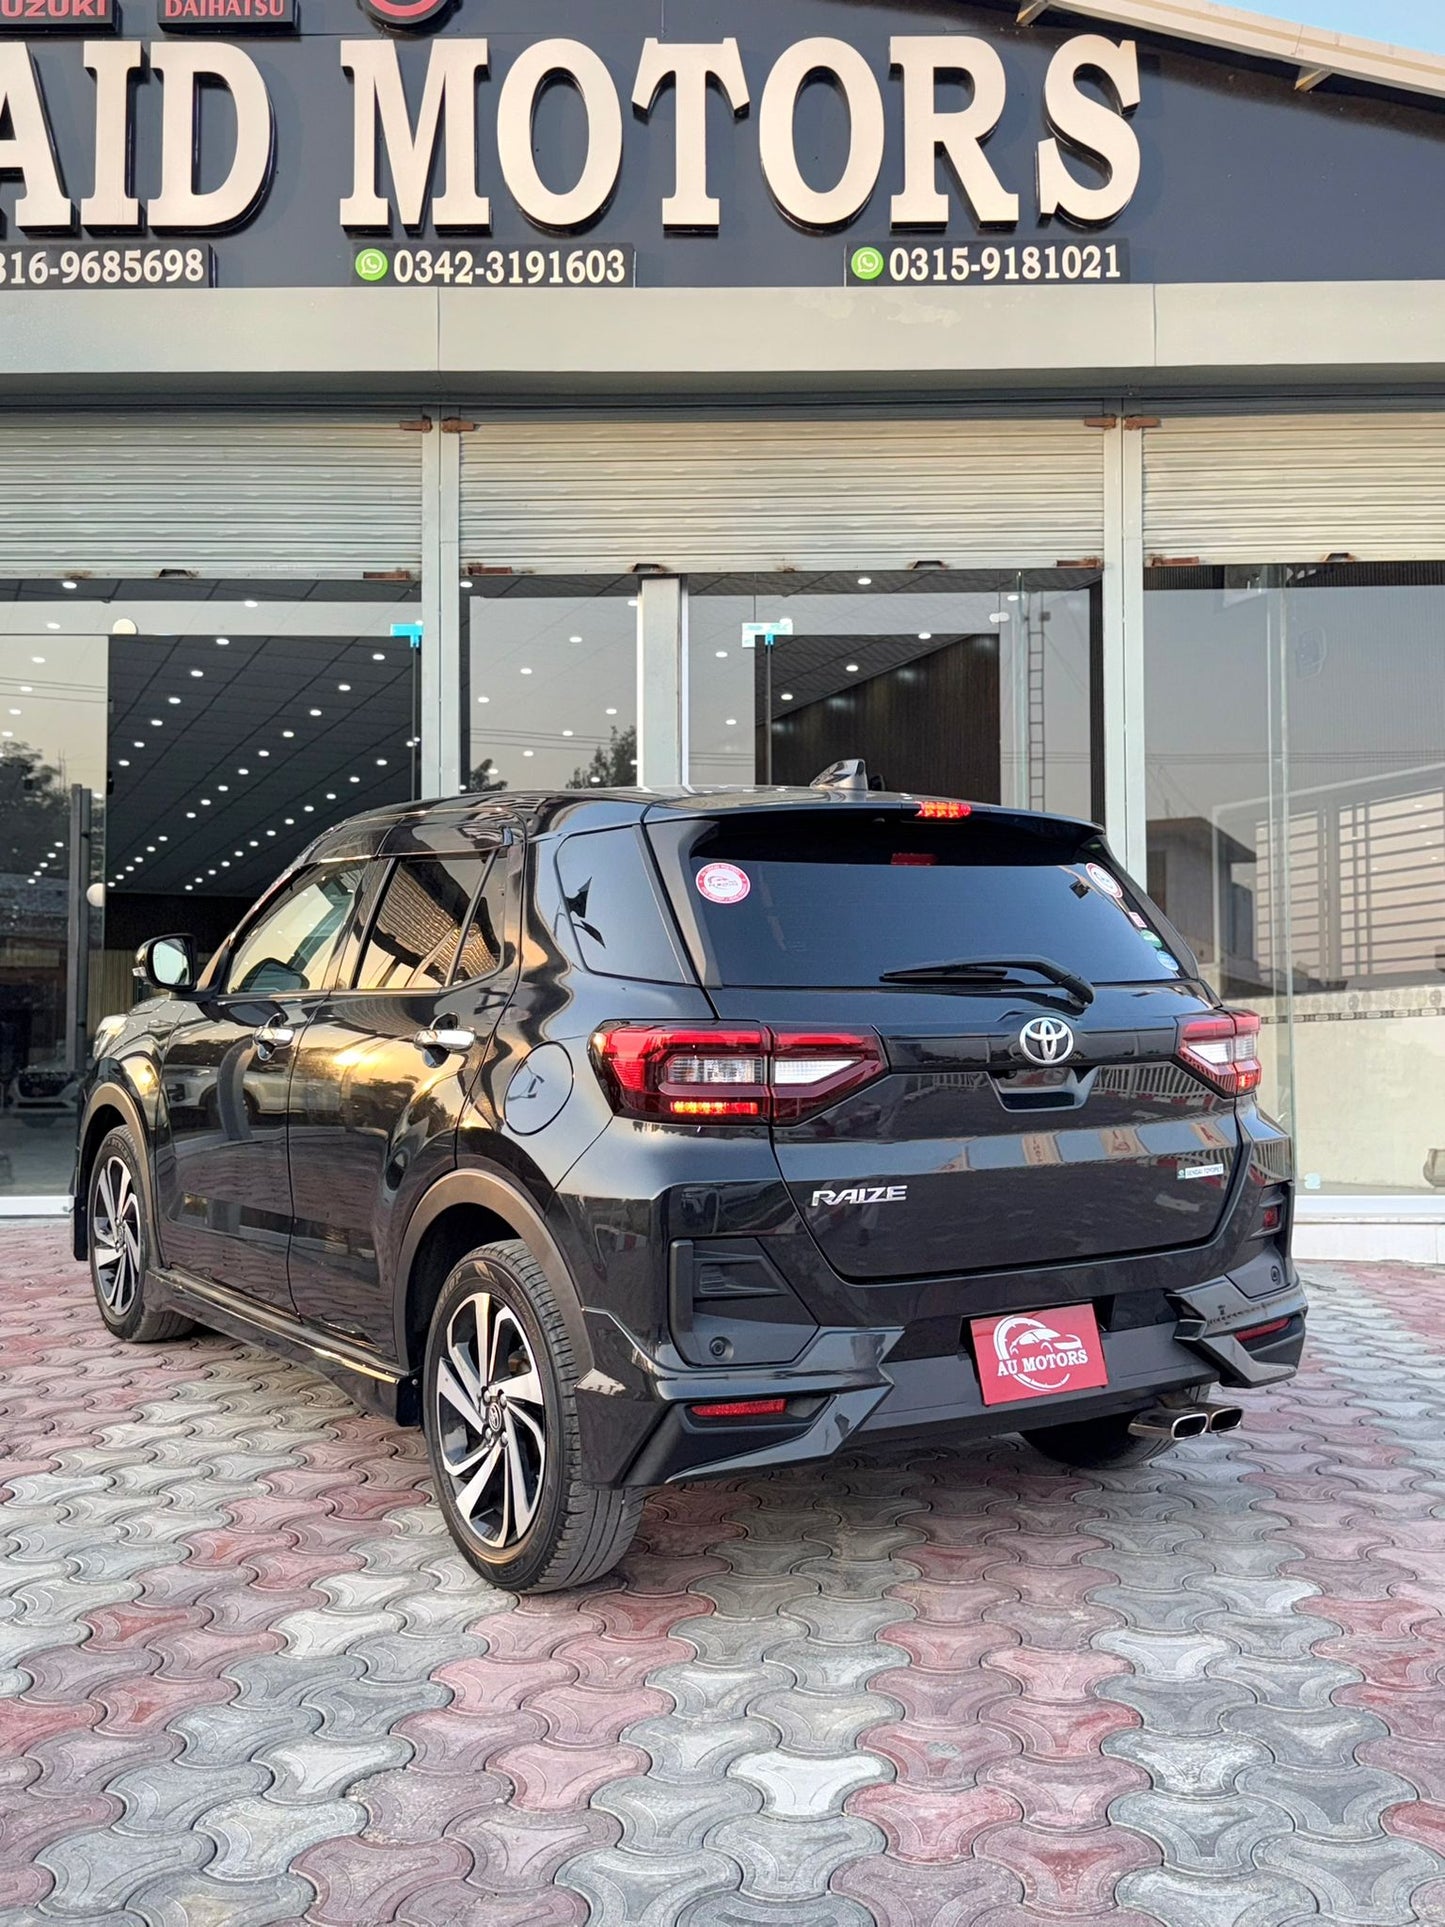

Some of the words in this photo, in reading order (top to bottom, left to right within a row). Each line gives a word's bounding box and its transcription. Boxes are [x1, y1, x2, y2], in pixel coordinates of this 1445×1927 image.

[165, 0, 284, 16] DAIHATSU
[340, 34, 1140, 227] MOTORS
[393, 249, 625, 284] 0342-3191603
[889, 244, 1121, 281] 0315-9181021
[811, 1185, 908, 1207] RAIZE
[997, 1359, 1018, 1377] AU
[1021, 1349, 1089, 1373] MOTORS
